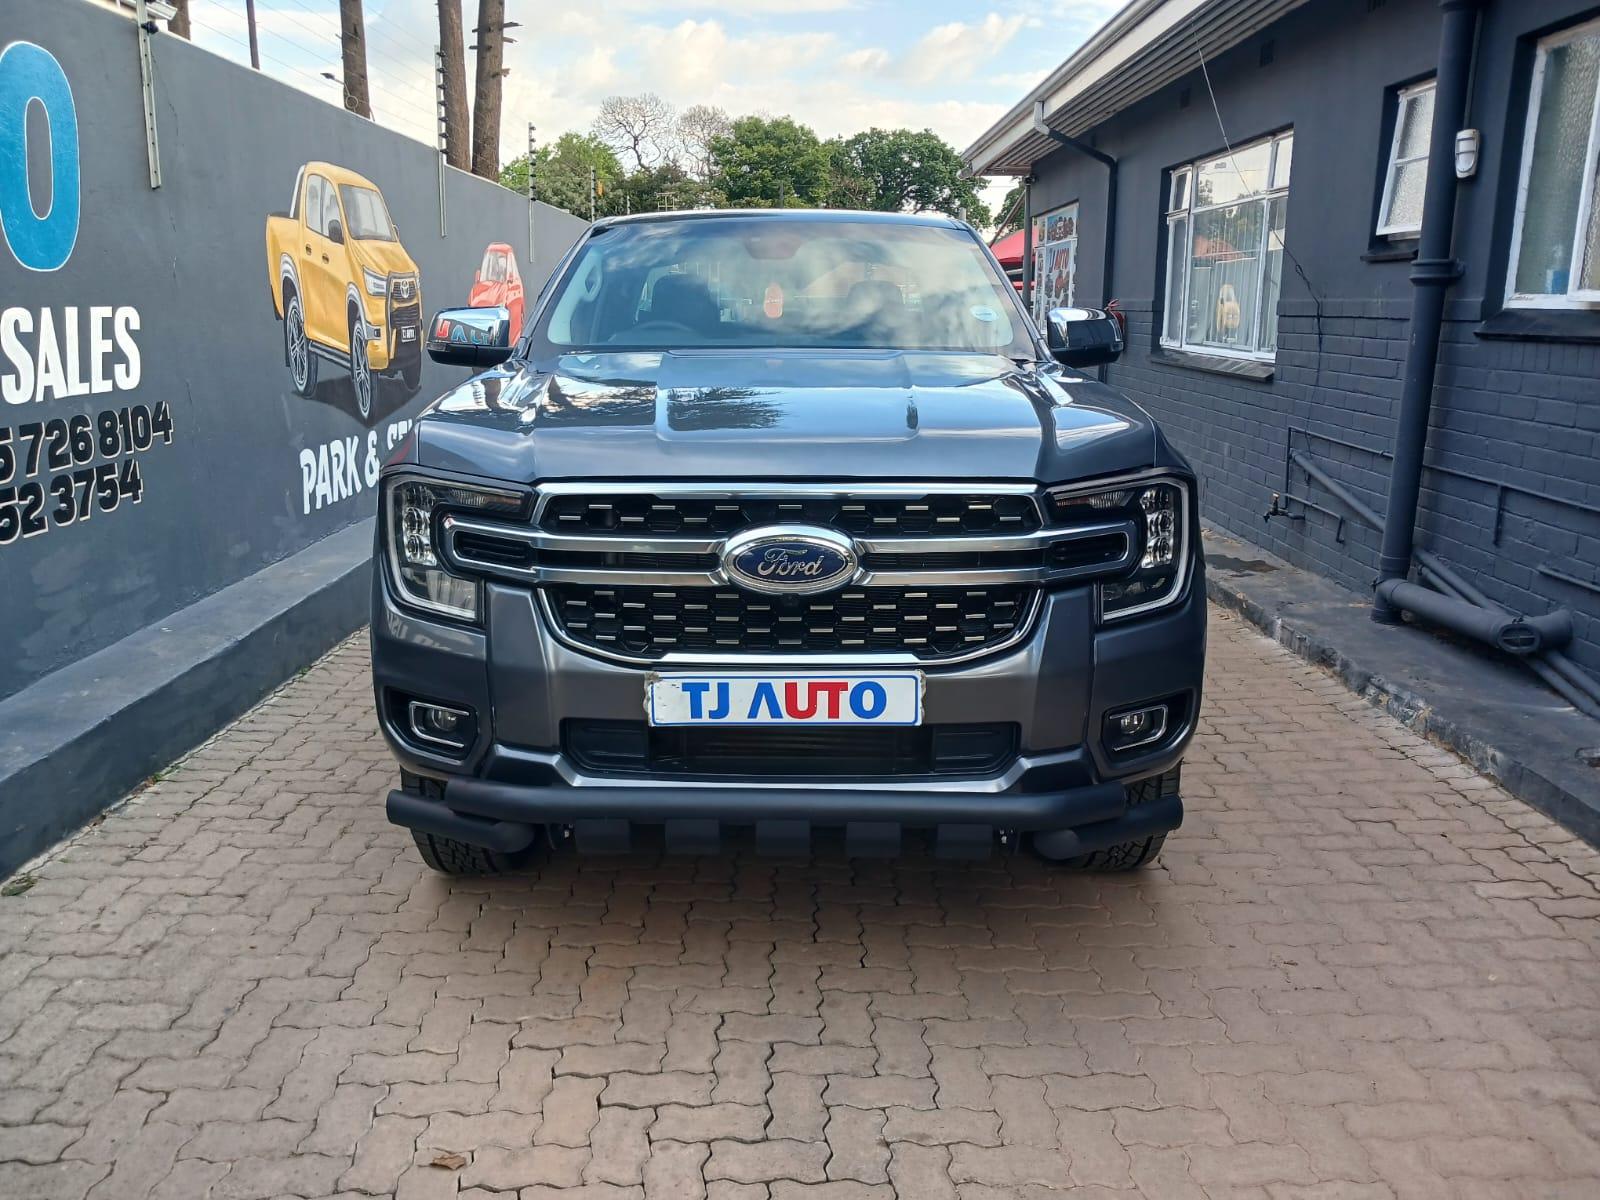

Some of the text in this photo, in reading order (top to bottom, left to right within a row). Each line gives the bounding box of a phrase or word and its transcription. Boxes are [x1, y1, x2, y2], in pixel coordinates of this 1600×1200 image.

[1, 306, 141, 404] SALES
[19, 422, 94, 477] 726
[98, 401, 173, 458] 8104
[300, 436, 362, 514] PARK
[365, 430, 380, 488] &
[51, 459, 143, 526] 3754
[758, 547, 824, 575] Ford
[682, 681, 887, 720] TJ AUTO
